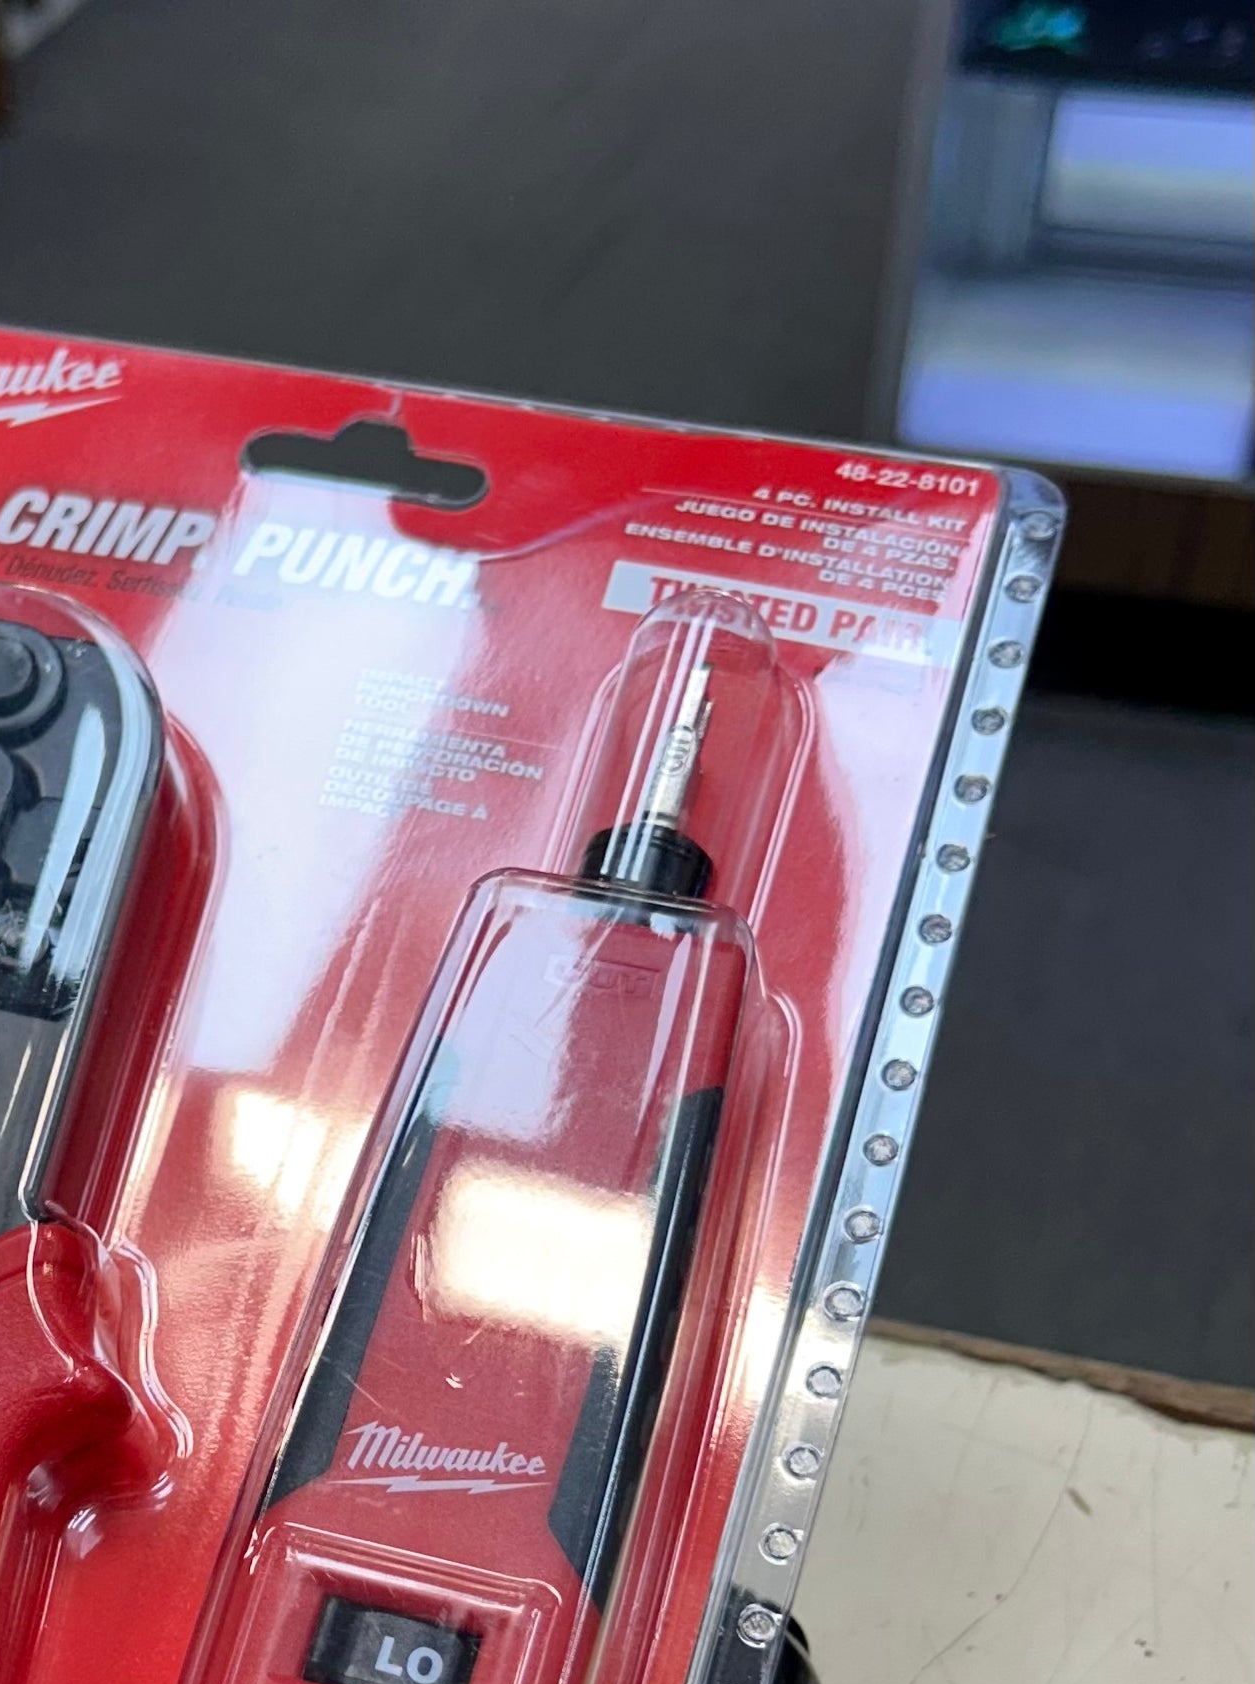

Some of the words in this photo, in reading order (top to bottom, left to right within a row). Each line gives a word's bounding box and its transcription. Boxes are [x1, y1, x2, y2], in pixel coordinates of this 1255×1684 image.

[835, 462, 980, 497] 48-22-8101
[752, 488, 770, 501] 4
[775, 489, 817, 508] PC.
[823, 498, 921, 525] INSTALL
[926, 513, 968, 533] KIT
[674, 500, 755, 523] JUEGO
[761, 511, 795, 529] DE
[799, 518, 962, 558] INSTALACIÓN
[232, 521, 481, 611] PUNCH.
[624, 522, 753, 555] ENSEMBLE
[758, 543, 948, 589] D'INSTALLATION
[822, 536, 856, 553] DE
[861, 543, 879, 557] 4
[883, 547, 956, 572] PZAS.
[817, 569, 853, 586] DE
[857, 576, 875, 590] 4
[880, 580, 947, 602] PCES
[335, 746, 368, 763] DE
[339, 732, 371, 747] DE
[328, 765, 394, 789] OUTIL
[400, 778, 435, 795] DE
[343, 1420, 547, 1477] Milwaukee
